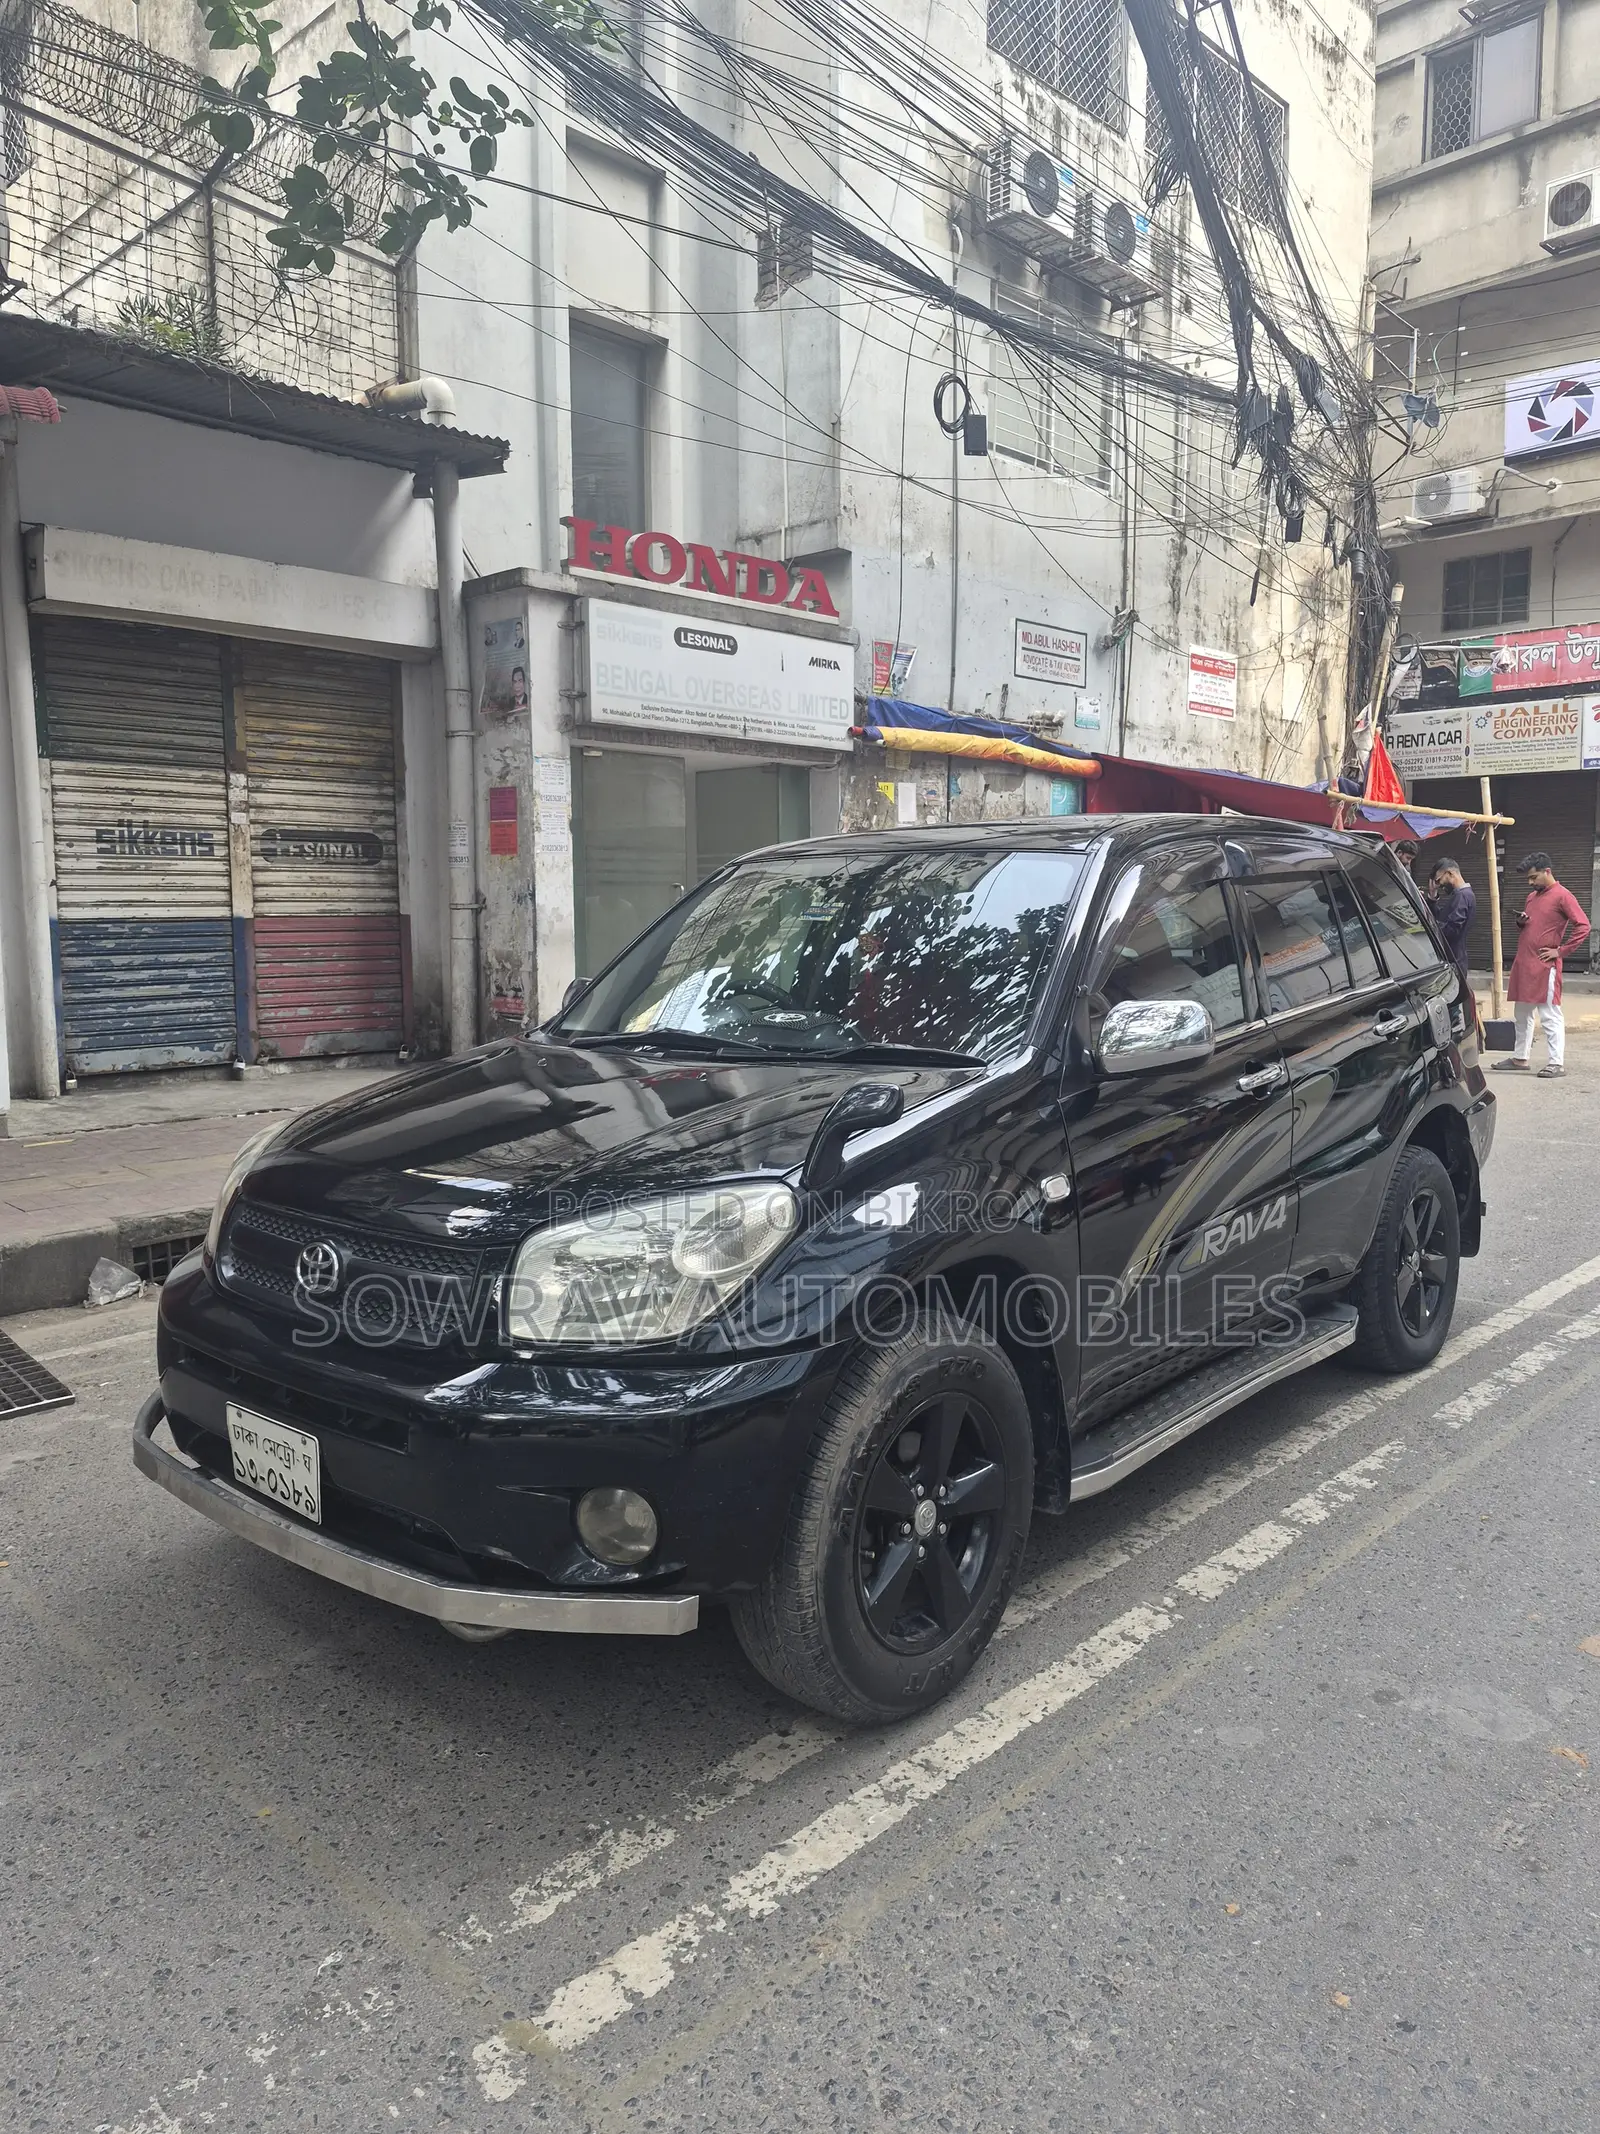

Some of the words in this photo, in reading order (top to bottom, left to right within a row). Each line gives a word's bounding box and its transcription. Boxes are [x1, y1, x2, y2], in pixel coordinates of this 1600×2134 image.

[160, 563, 205, 596] CAR
[562, 516, 840, 617] HONDA
[596, 623, 663, 650] sikkens
[1034, 634, 1050, 649] ABUL
[1052, 638, 1080, 653] HASHEM
[808, 656, 841, 671] MIRKA
[1023, 654, 1048, 668] ADVOCATE
[596, 661, 679, 697] BENGAL
[685, 676, 782, 713] OVERSEAS
[787, 693, 849, 720] LIMITED
[1493, 713, 1579, 730] ENGINEERING
[1494, 703, 1579, 719] JALIL
[1397, 733, 1426, 749] RENT
[1427, 731, 1436, 746] A
[1438, 730, 1462, 745] CAR
[1493, 724, 1578, 740] COMPANY
[95, 819, 215, 857] sikkens
[1201, 1195, 1287, 1264] RAV4
[232, 1423, 258, 1450] ঢাকা
[234, 1451, 316, 1514] ১৩-০১৮৯
